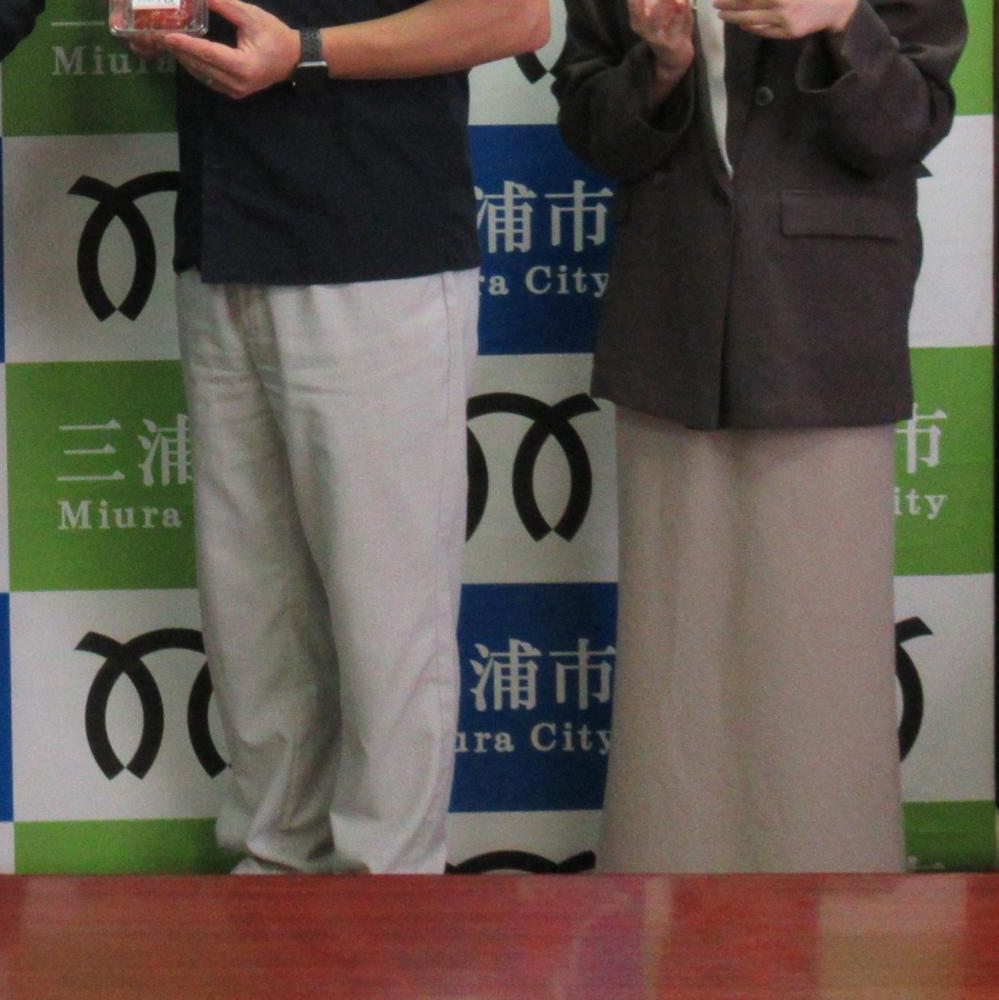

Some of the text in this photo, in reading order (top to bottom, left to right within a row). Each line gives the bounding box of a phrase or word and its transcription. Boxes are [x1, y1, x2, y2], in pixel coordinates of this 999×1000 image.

[474, 180, 614, 254] 浦市
[525, 265, 610, 298] City
[56, 413, 193, 487] 三浦
[57, 499, 182, 530] Miura
[894, 486, 948, 520] ity
[469, 638, 617, 711] 浦市
[530, 721, 613, 755] City
